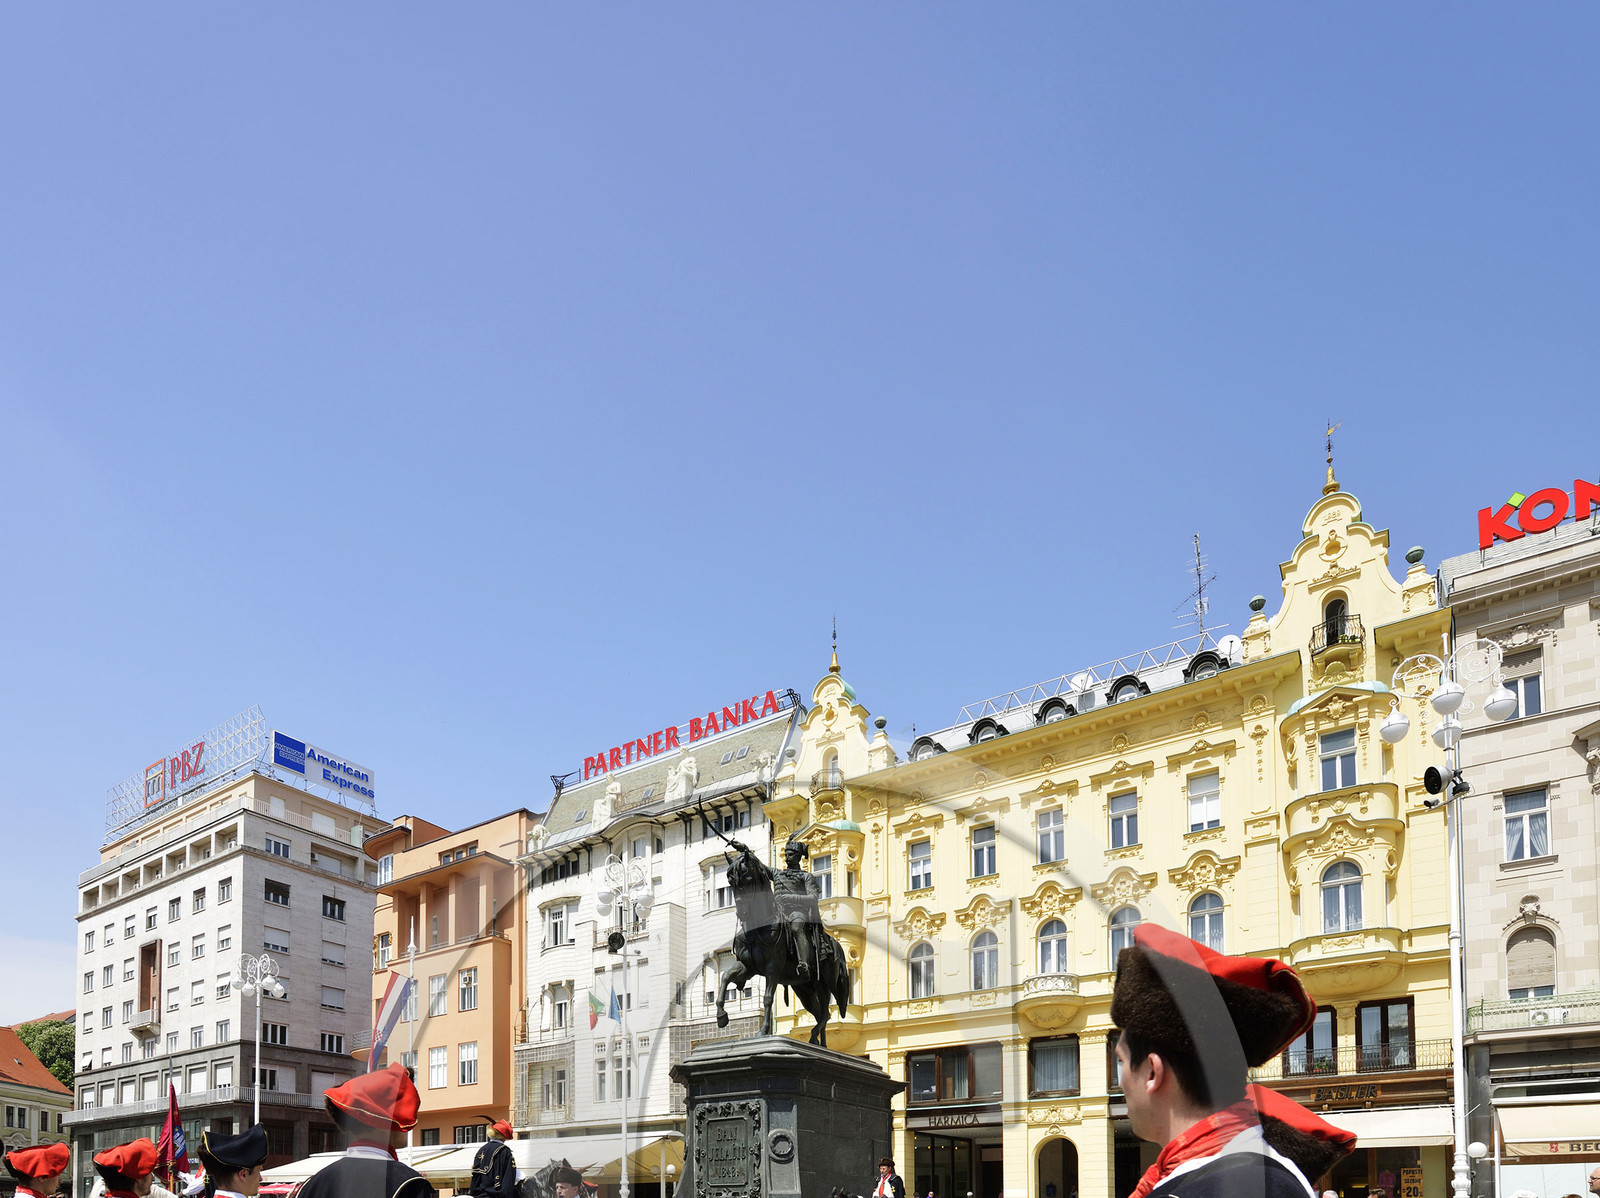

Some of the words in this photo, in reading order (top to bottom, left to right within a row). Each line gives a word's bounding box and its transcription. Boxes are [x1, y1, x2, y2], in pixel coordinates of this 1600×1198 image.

[584, 726, 679, 780] PARTNER
[689, 690, 779, 743] BANKA
[275, 742, 304, 759] AMERICAN
[280, 751, 305, 765] EXPRESS
[170, 741, 205, 790] PBZ
[307, 748, 369, 782] American
[323, 768, 375, 798] Express
[1315, 1085, 1378, 1101] BASLER
[928, 1114, 980, 1126] HARMICA
[717, 1127, 737, 1141] BAN
